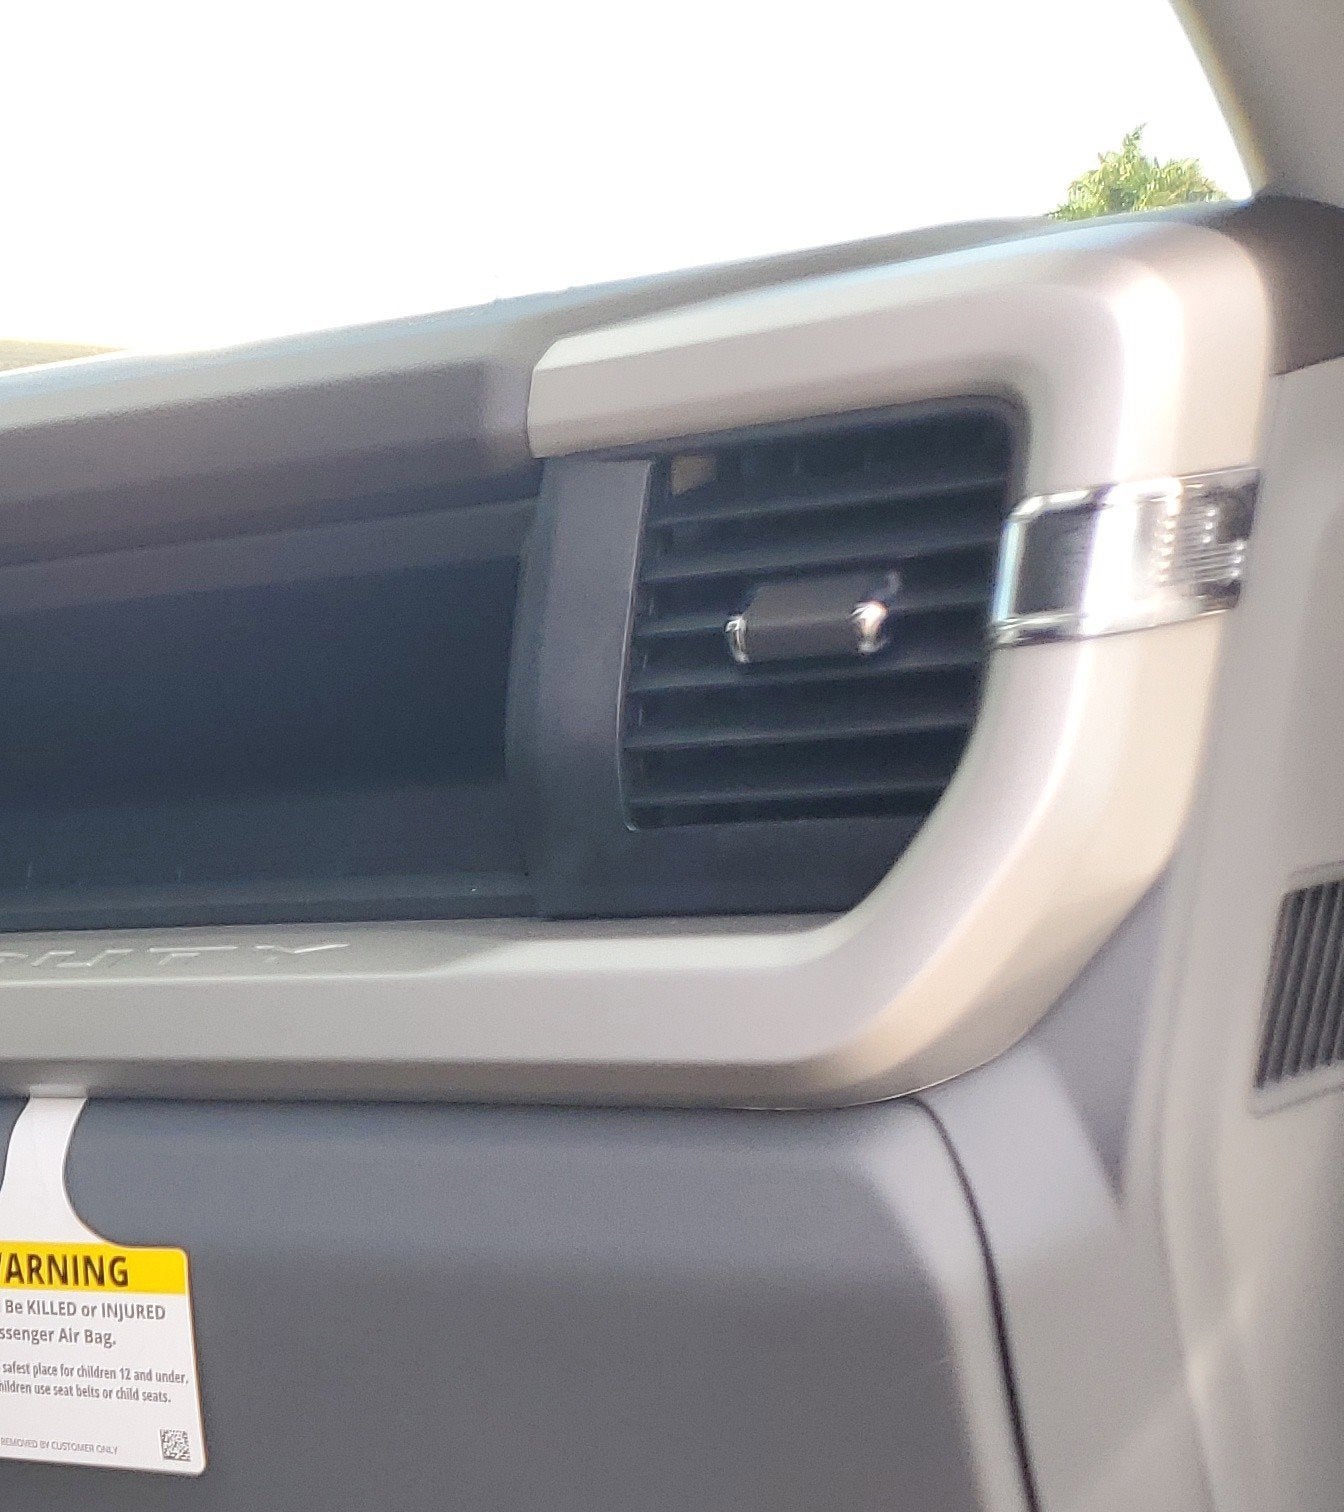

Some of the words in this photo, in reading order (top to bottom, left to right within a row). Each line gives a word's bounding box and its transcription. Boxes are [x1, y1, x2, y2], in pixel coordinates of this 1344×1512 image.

[5, 1299, 23, 1314] Be
[27, 1300, 77, 1317] KILLED
[81, 1304, 97, 1318] or
[101, 1303, 166, 1322] INJURED
[58, 1327, 80, 1344] Air
[84, 1329, 116, 1349] Bag.
[2, 1360, 30, 1375] safest
[32, 1362, 58, 1378] place
[60, 1363, 75, 1377] for
[76, 1364, 117, 1380] children
[119, 1367, 131, 1380] 12
[133, 1368, 153, 1382] and
[34, 1384, 52, 1396] use
[53, 1384, 74, 1397] seat
[75, 1383, 100, 1399] belts
[102, 1388, 114, 1399] or
[115, 1386, 140, 1401] child
[141, 1390, 172, 1403] seats.
[0, 1437, 38, 1449] REMOVED
[51, 1441, 94, 1453] CUSTOMER
